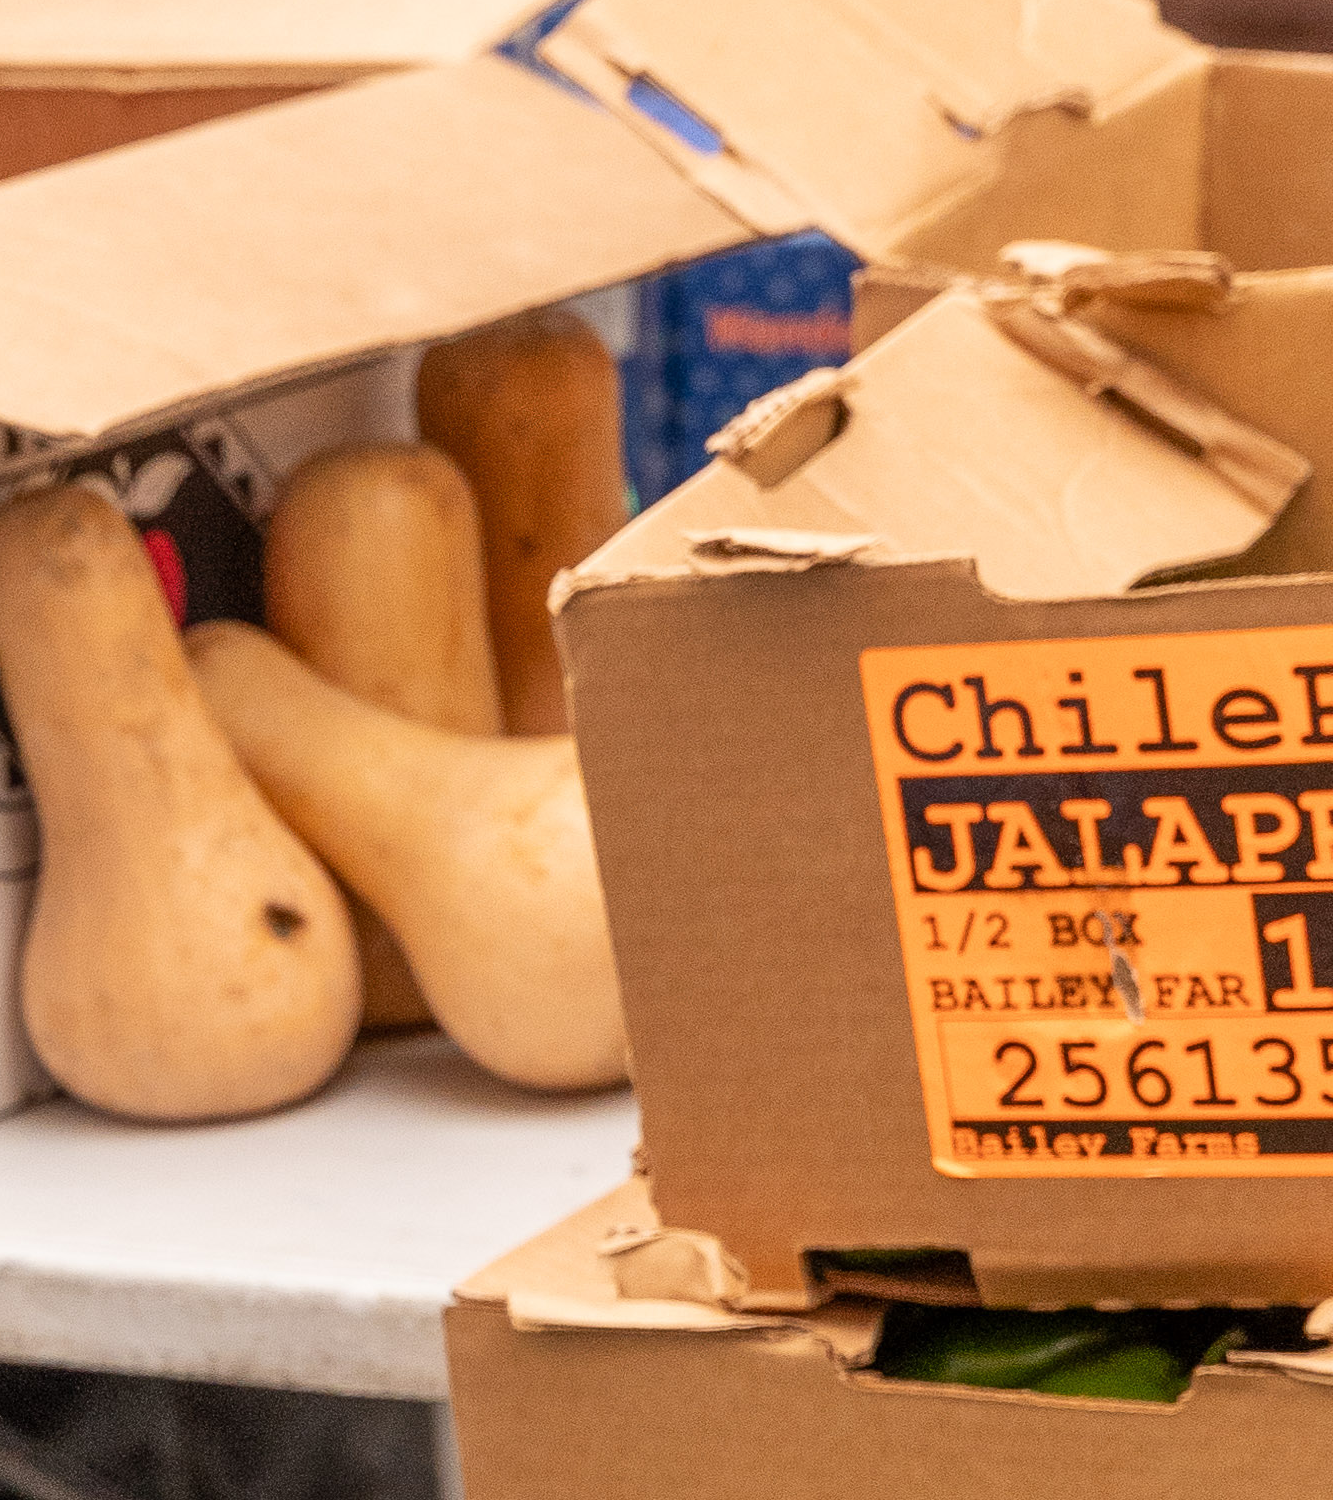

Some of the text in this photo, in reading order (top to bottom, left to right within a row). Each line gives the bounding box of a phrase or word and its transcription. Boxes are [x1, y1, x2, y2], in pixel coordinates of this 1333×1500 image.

[921, 910, 1012, 956] 1/2
[930, 972, 1251, 1012] BAILEY FAR
[1128, 1124, 1262, 1159] Farms
